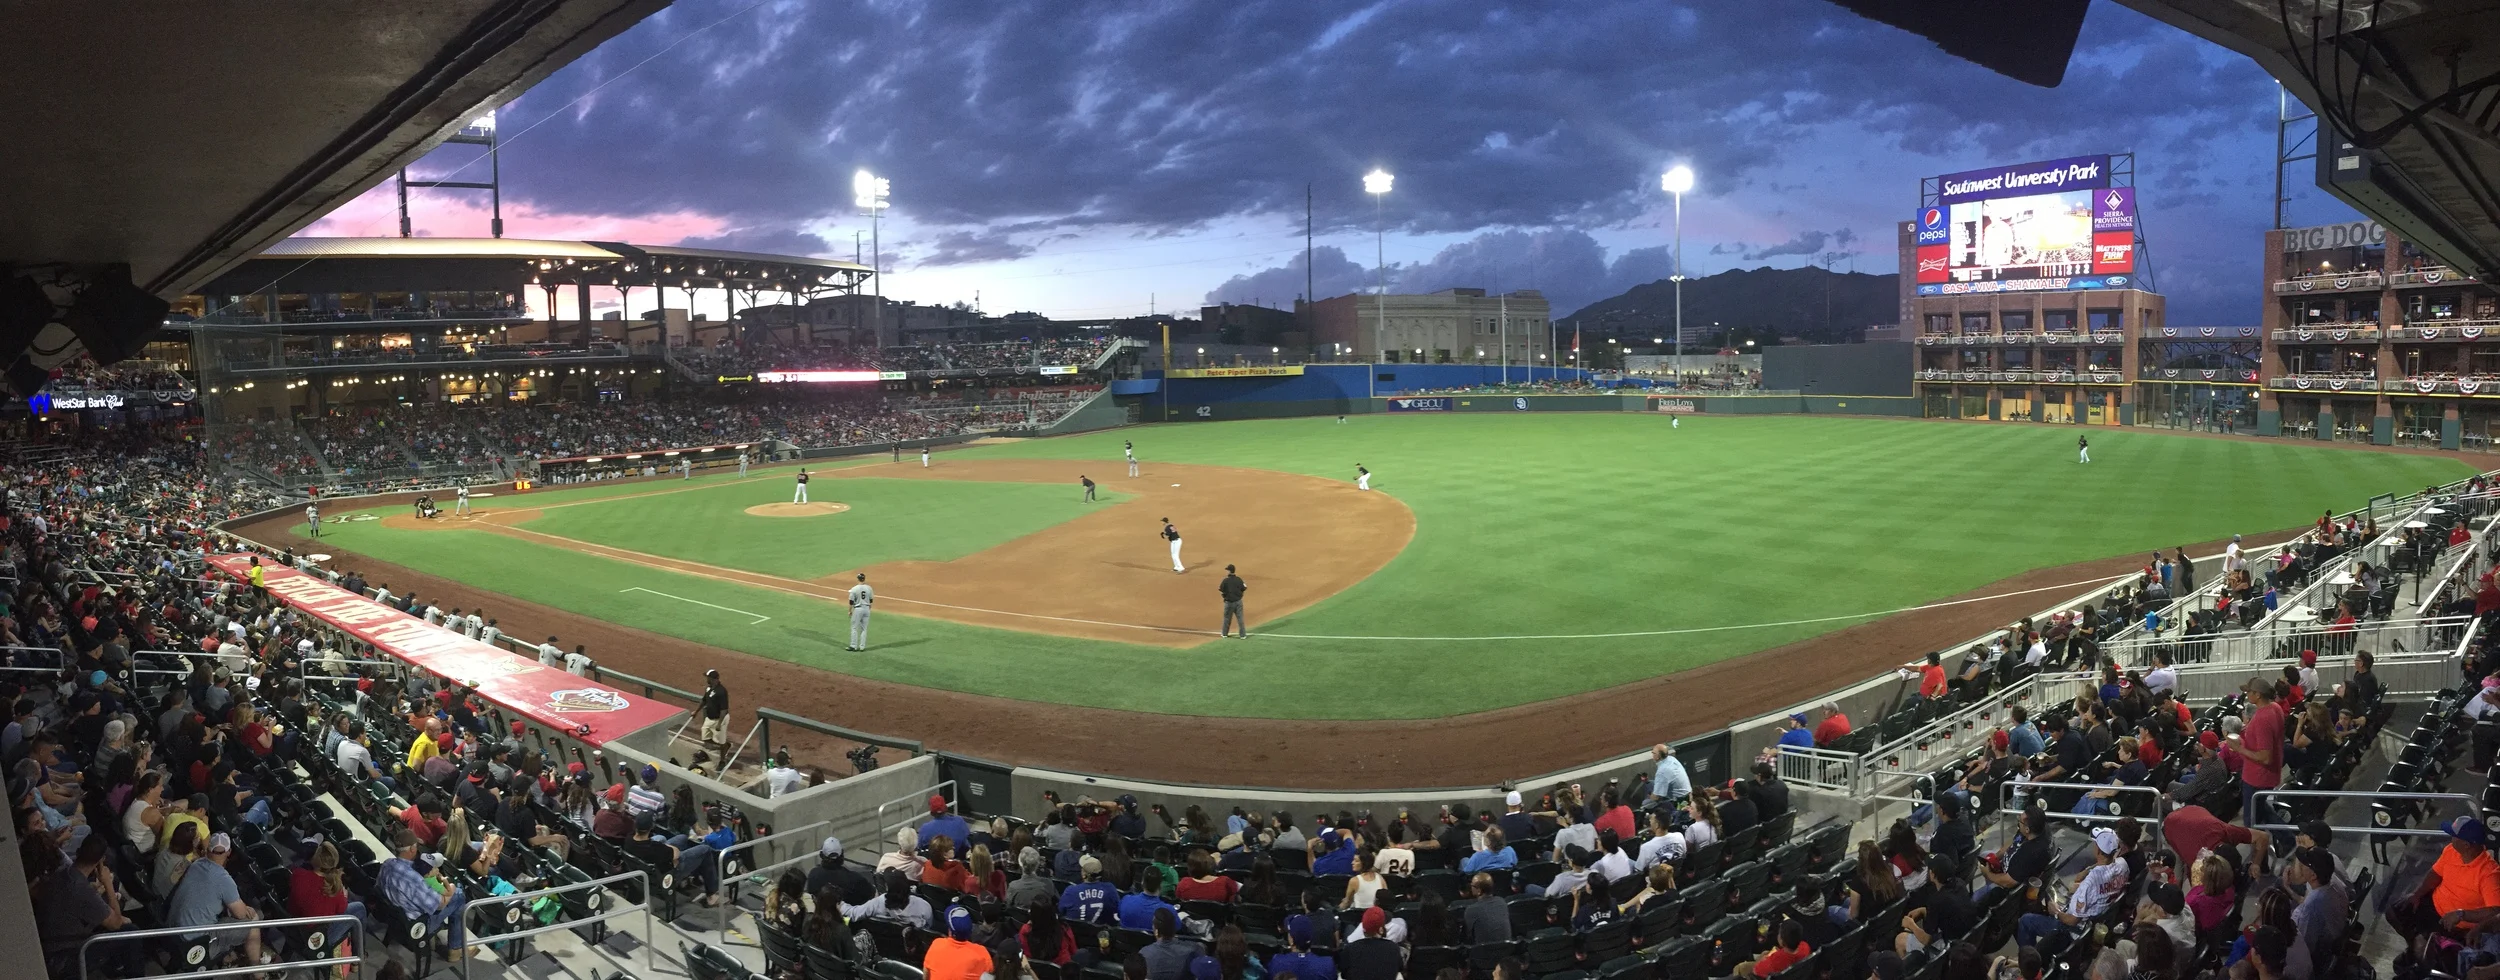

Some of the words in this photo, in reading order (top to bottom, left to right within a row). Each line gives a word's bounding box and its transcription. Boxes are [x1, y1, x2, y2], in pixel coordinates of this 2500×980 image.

[1943, 176, 2003, 196] Southwest
[2004, 168, 2067, 189] University
[2068, 162, 2099, 181] Park
[2094, 215, 2133, 224] PROVIDENCE
[1919, 228, 1946, 242] pepsi
[2285, 227, 2324, 252] BIG
[2331, 222, 2386, 247] DOG
[1942, 283, 1971, 294] CASA
[1975, 281, 1999, 293] VIVA
[2006, 278, 2071, 290] SHAMALEY
[52, 398, 86, 409] WestStar
[88, 397, 106, 408] Bank
[1411, 399, 1445, 408] GECU
[1196, 406, 1212, 417] 42
[1389, 858, 1409, 876] 24
[1078, 888, 1104, 901] CHOO
[1079, 902, 1104, 923] 17
